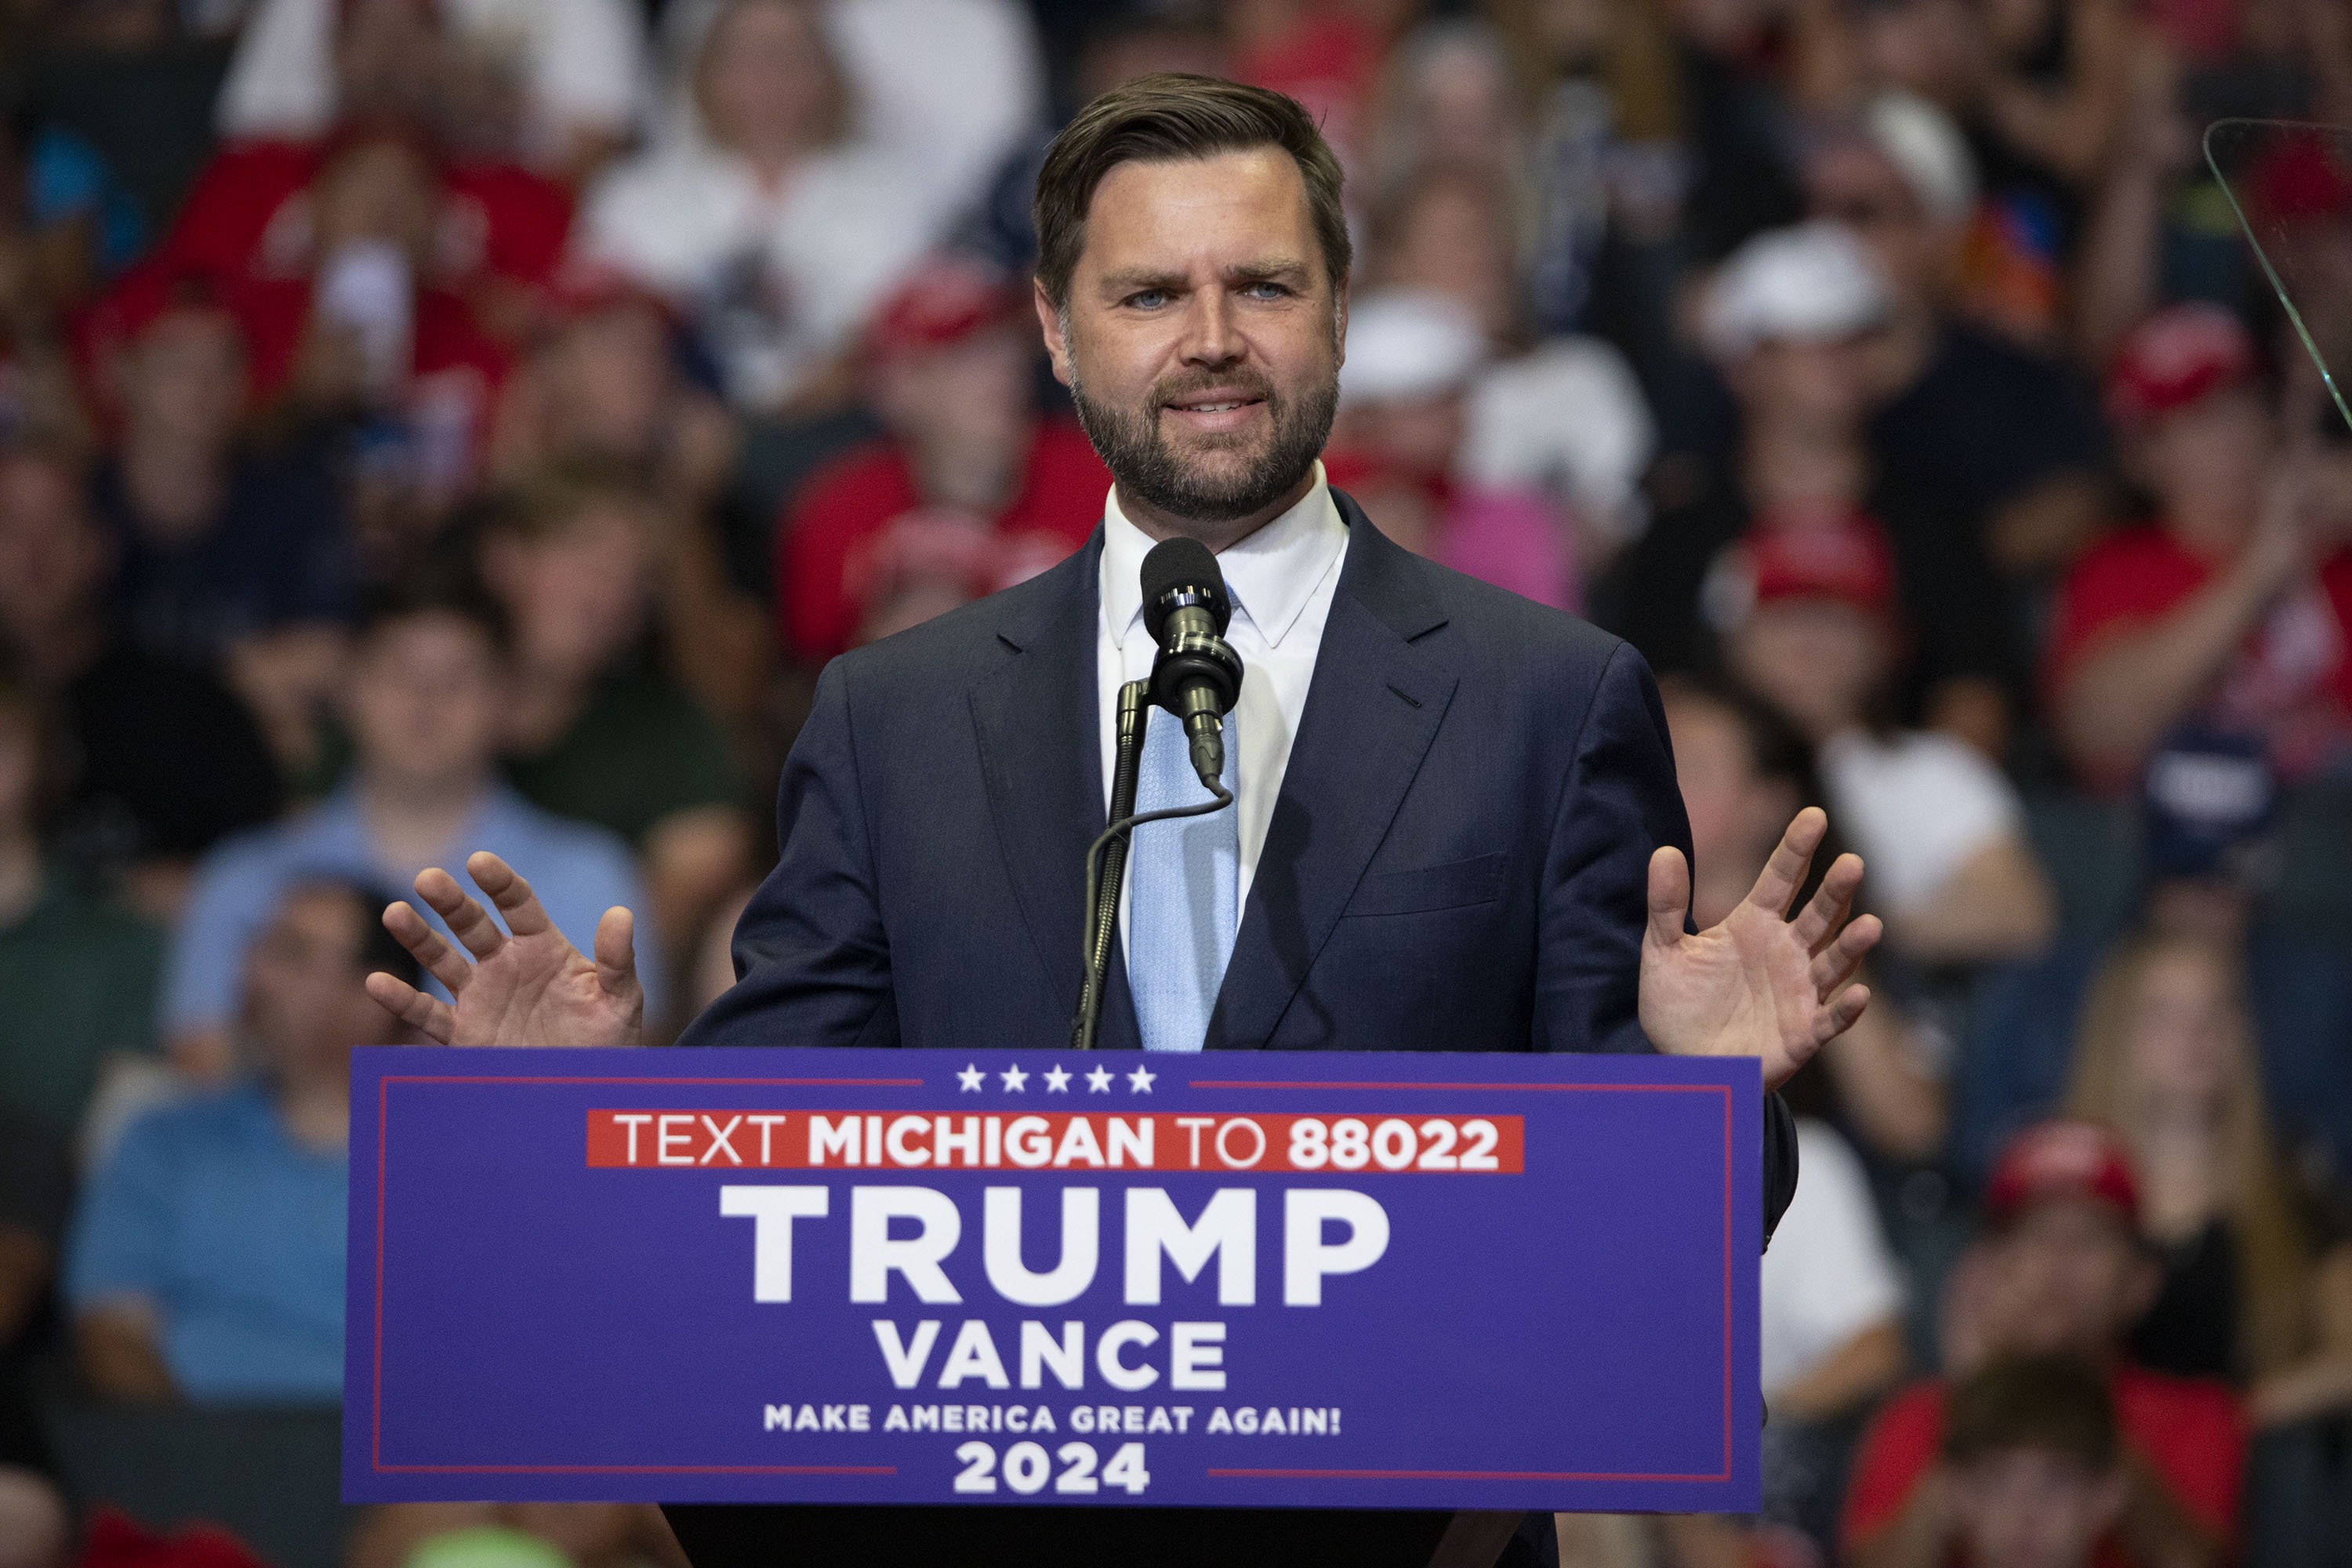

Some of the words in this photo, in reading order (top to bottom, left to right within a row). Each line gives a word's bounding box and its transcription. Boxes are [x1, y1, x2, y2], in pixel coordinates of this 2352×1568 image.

[613, 1115, 786, 1165] TEXT
[808, 1115, 1155, 1168] MICHIGAN
[1176, 1118, 1266, 1168] TO
[1288, 1118, 1499, 1170] 88022
[720, 1185, 1389, 1307] TRUMP
[873, 1320, 1226, 1392] VANCE
[764, 1405, 870, 1432] MAKE
[884, 1405, 1056, 1433] AMERICA
[1070, 1406, 1193, 1433] GREAT
[1207, 1407, 1341, 1435] AGAIN!
[954, 1442, 1150, 1494] 2024
